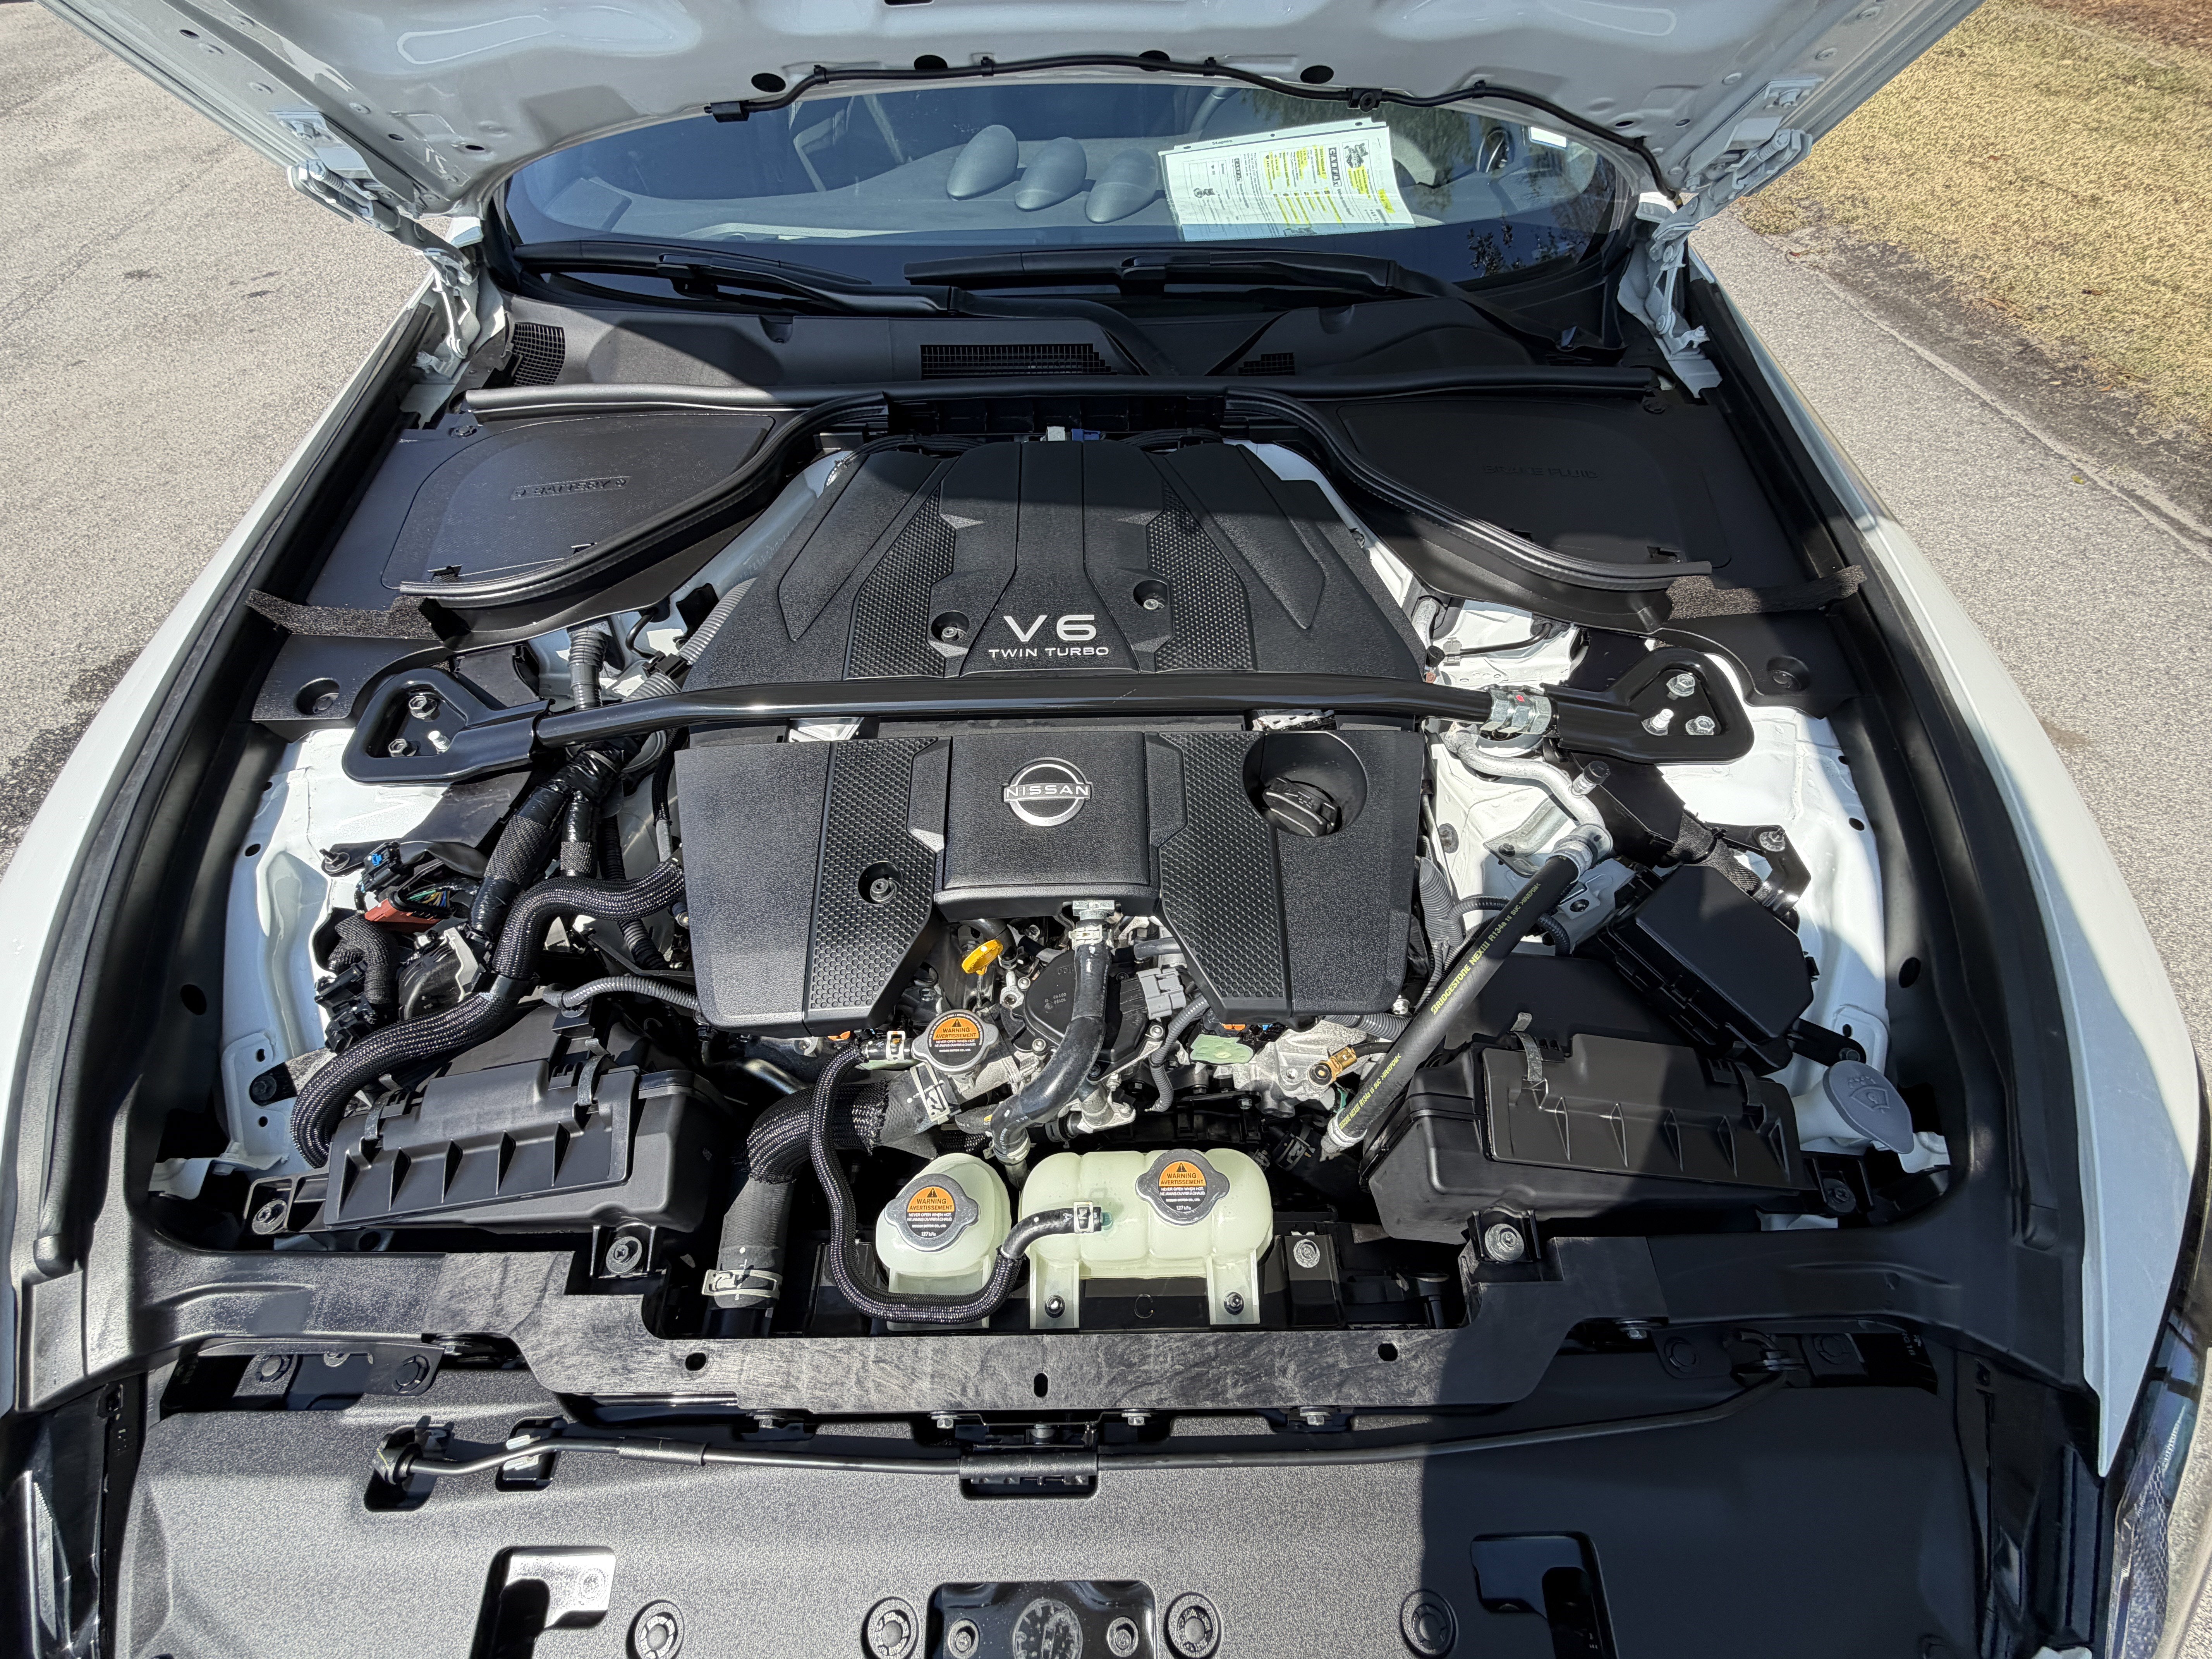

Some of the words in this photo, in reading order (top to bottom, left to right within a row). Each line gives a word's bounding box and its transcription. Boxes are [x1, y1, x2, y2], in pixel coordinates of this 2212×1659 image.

[1328, 147, 1342, 187] CARFAX
[1483, 465, 1544, 476] BRAKE
[1548, 467, 1599, 479] FLUID
[534, 480, 611, 494] BATTERY
[1003, 614, 1097, 642] V6
[988, 648, 1037, 658] TWIN
[1045, 647, 1109, 657] TURBO
[1006, 785, 1089, 799] NISSAN
[1431, 964, 1471, 1015] BRIDGESTONE
[1488, 922, 1507, 941] R134a
[1510, 905, 1521, 915] SUC
[1359, 1092, 1371, 1107] R134a
